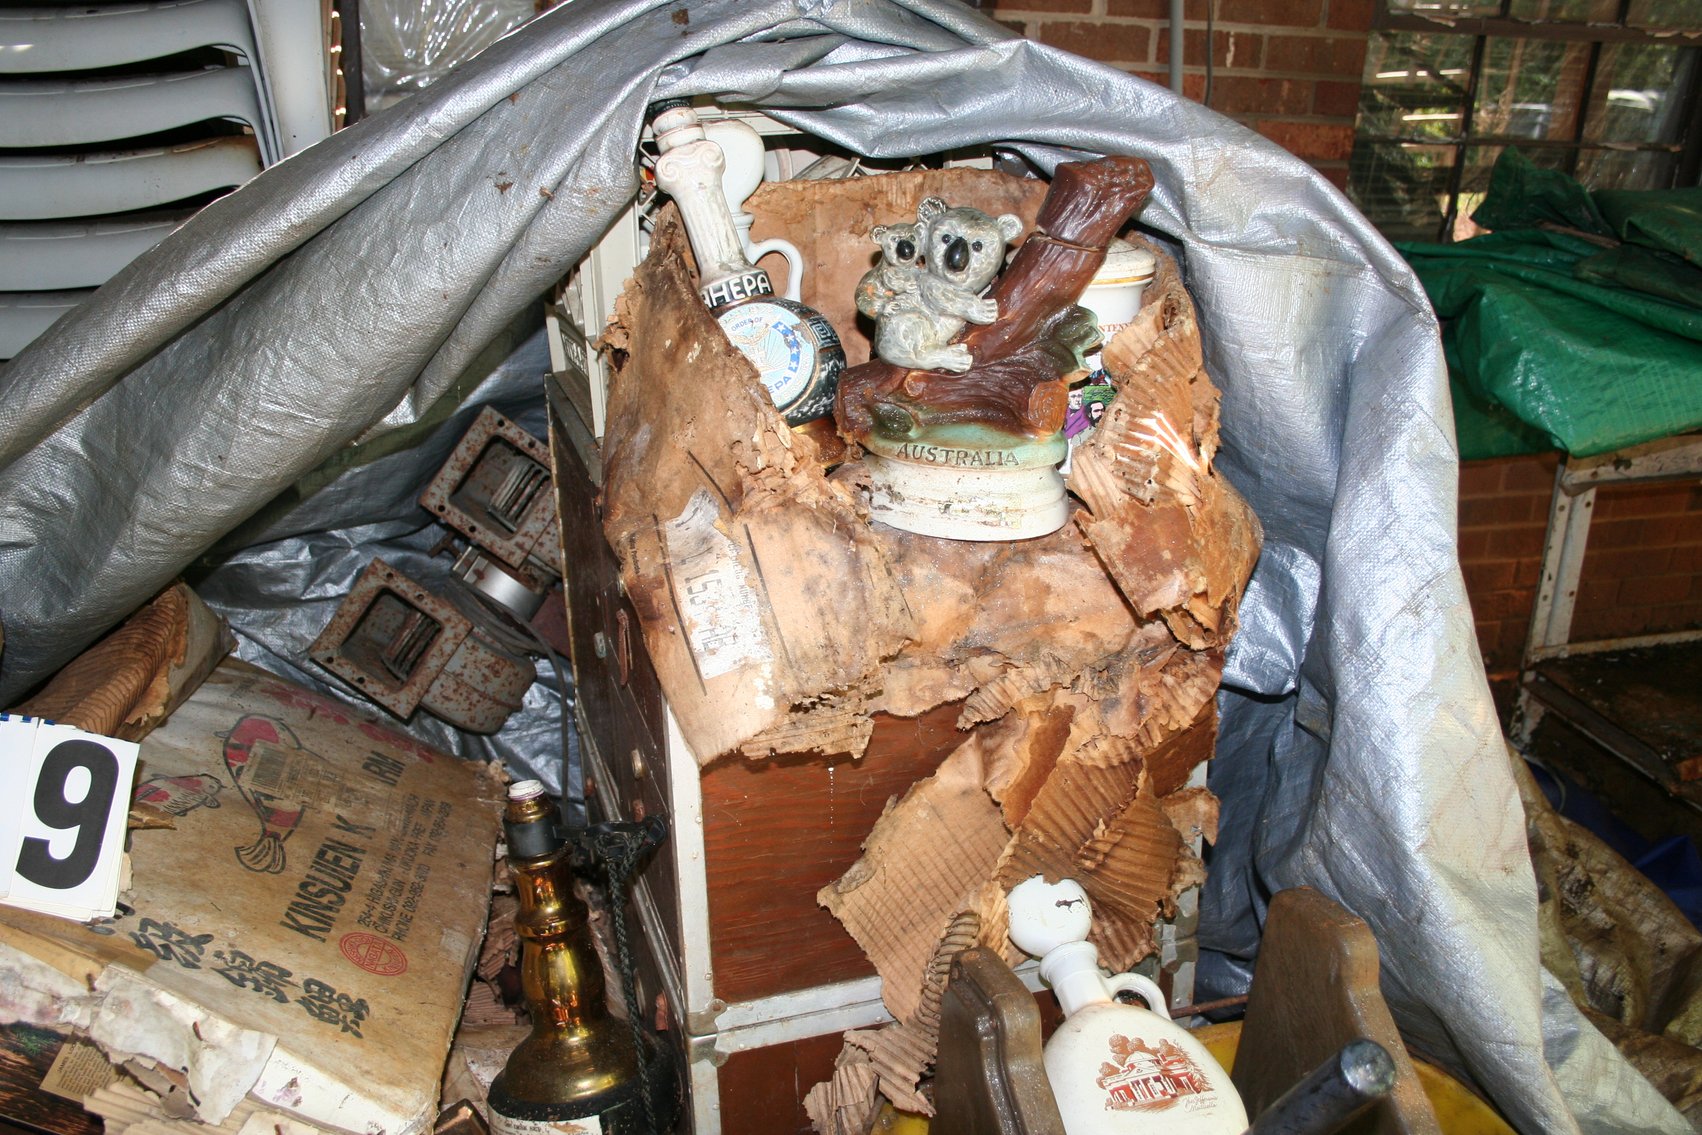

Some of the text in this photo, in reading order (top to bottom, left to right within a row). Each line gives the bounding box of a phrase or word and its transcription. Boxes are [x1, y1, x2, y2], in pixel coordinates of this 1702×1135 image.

[731, 318, 753, 331] ORDER
[896, 442, 1019, 466] AUSTRALIA
[15, 739, 119, 890] 9
[280, 836, 368, 943] KINSUIEN
[391, 911, 414, 942] PHONE
[89, 901, 370, 1039] 級錦鯉
